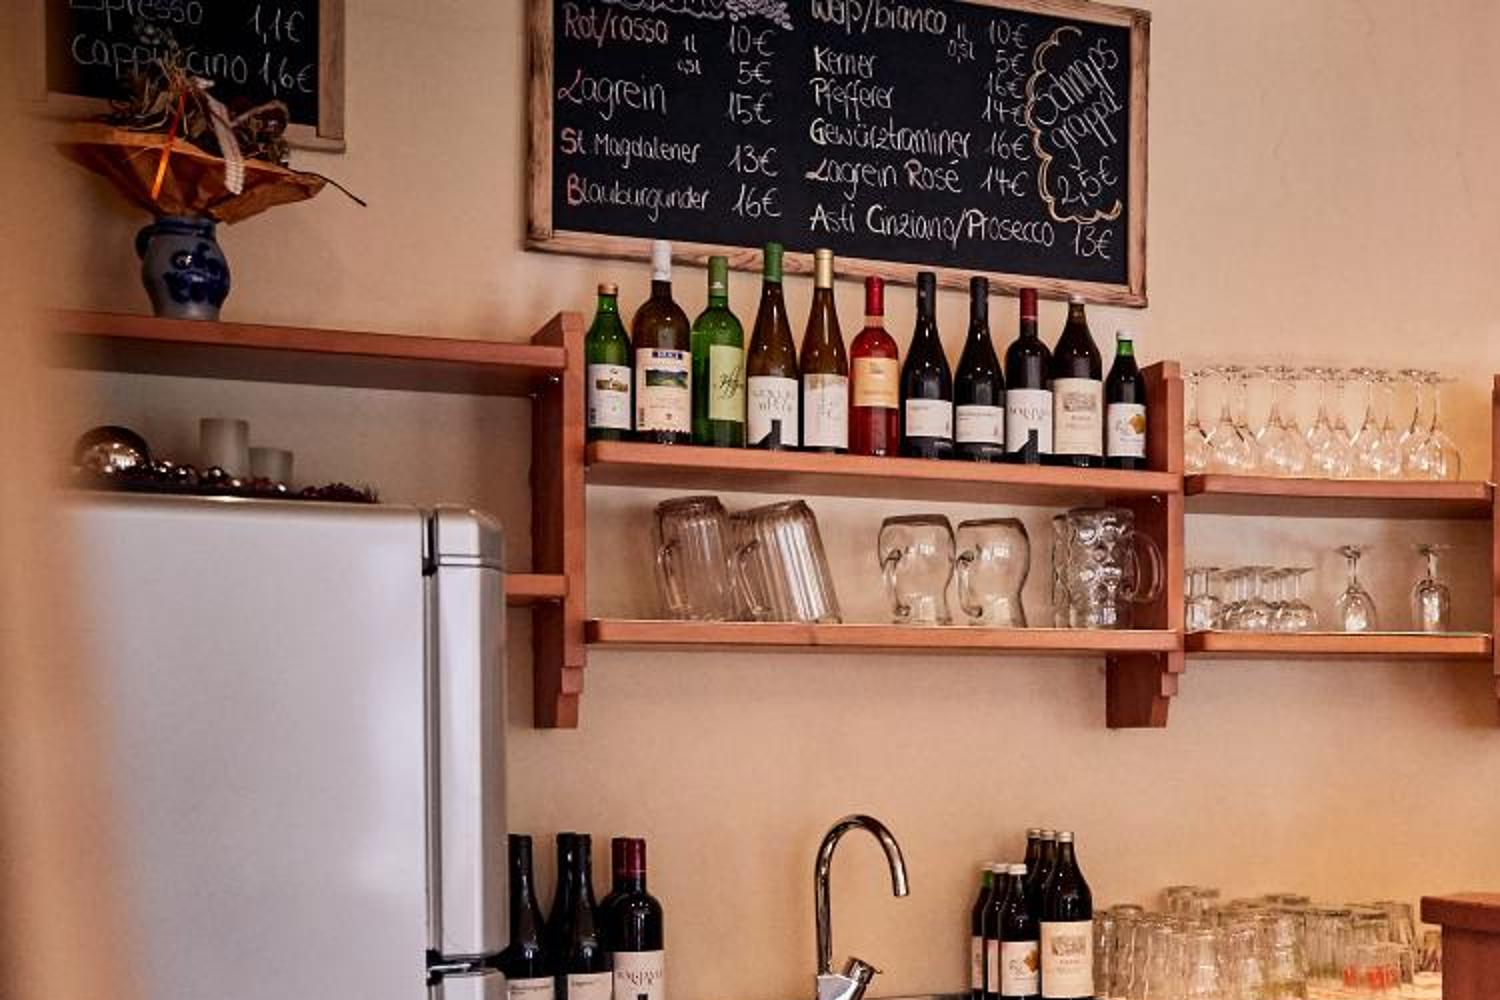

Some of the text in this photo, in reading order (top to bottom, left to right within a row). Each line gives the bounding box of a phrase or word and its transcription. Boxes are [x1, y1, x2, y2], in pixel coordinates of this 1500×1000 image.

[250, 5, 304, 44] 1,1€
[562, 4, 670, 48] Rot/rosso
[729, 25, 776, 56] 10€
[989, 20, 1029, 49] 10€
[258, 52, 316, 96] 1,6€
[737, 61, 772, 85] 5€
[813, 45, 877, 79] Kerner
[996, 49, 1025, 77] 5€
[557, 69, 772, 124] Lagrein 15€
[809, 77, 1028, 127] Pfefferer 14€
[594, 132, 702, 169] Magdalener
[729, 144, 778, 177] 13€
[809, 117, 1031, 161] Gewürztraminer 16€
[567, 173, 782, 222] Blauburgunder 16€
[805, 158, 1029, 200] Lagrein Rosé 14€
[1057, 155, 1119, 206] 2,5€
[809, 203, 856, 233] Asti
[1074, 222, 1113, 259] 13€
